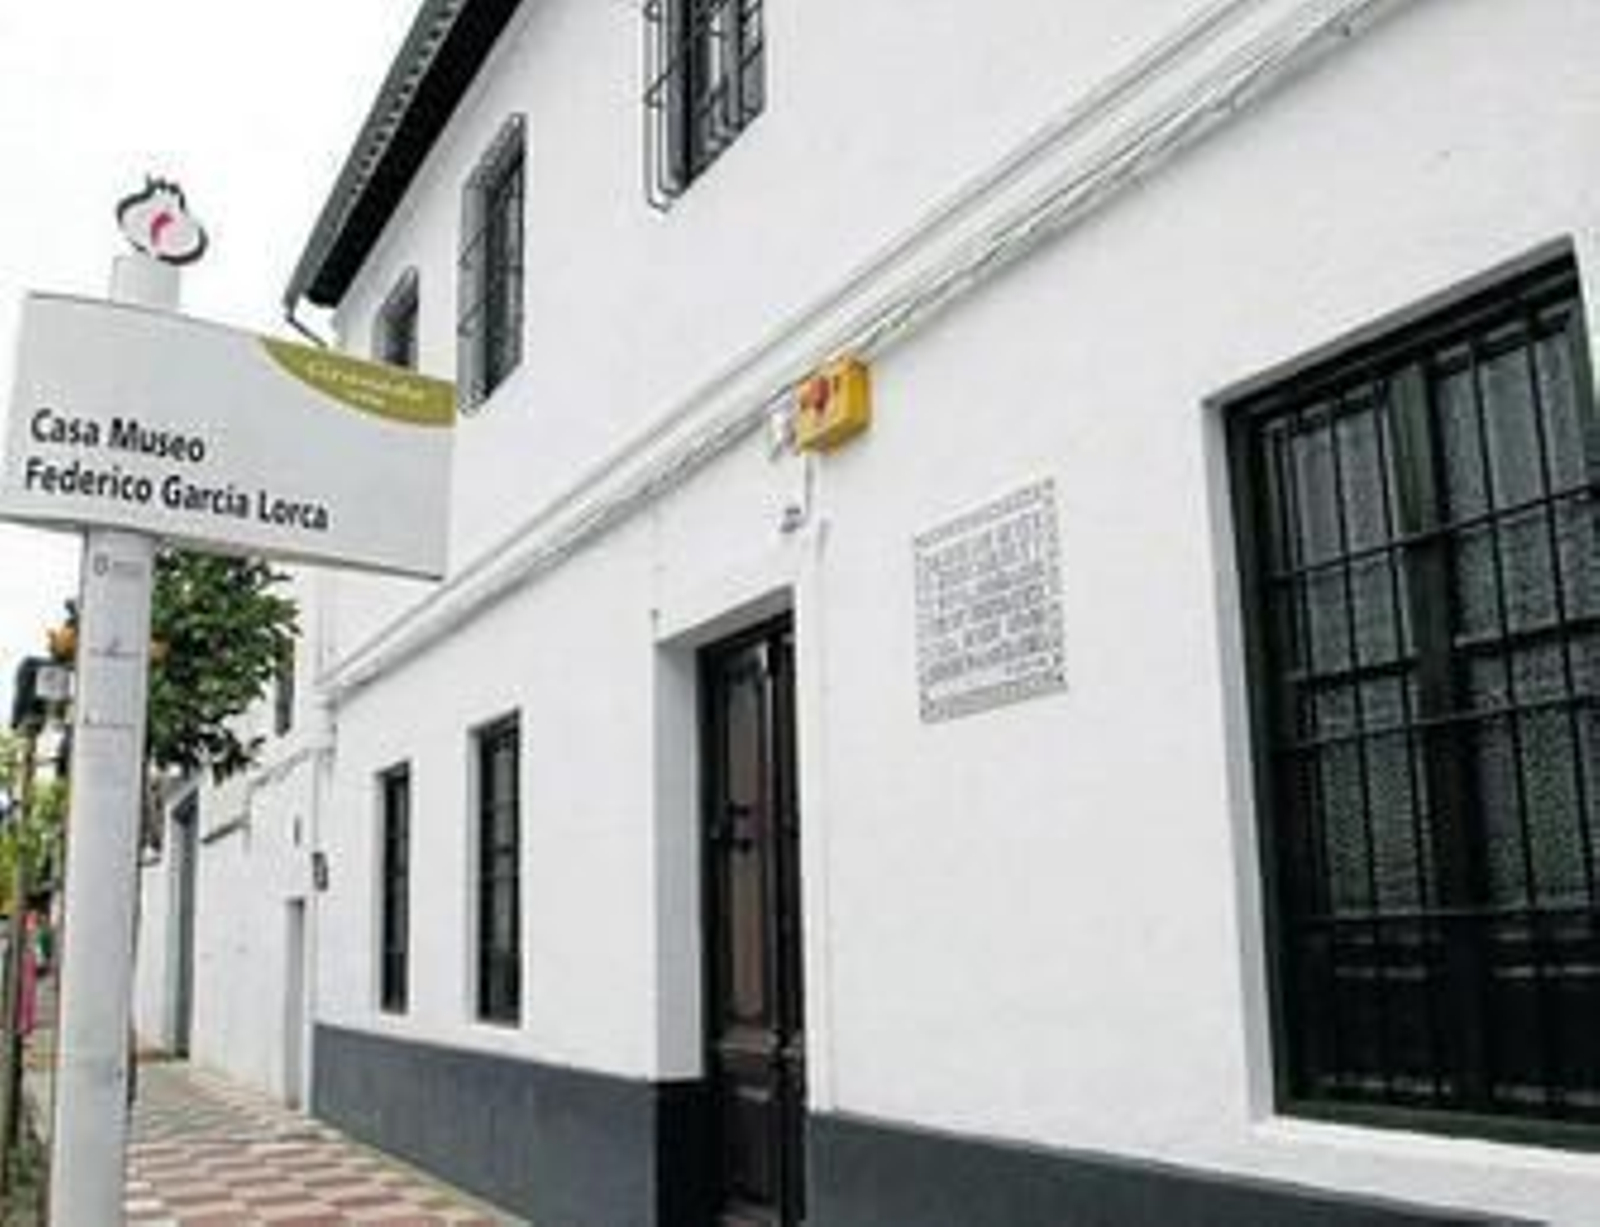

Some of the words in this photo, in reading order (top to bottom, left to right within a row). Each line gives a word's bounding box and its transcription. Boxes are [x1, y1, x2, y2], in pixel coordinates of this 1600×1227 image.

[30, 407, 101, 446] Casa
[107, 416, 206, 463] Museo
[25, 456, 153, 505] Federico
[258, 489, 329, 532] Lorca
